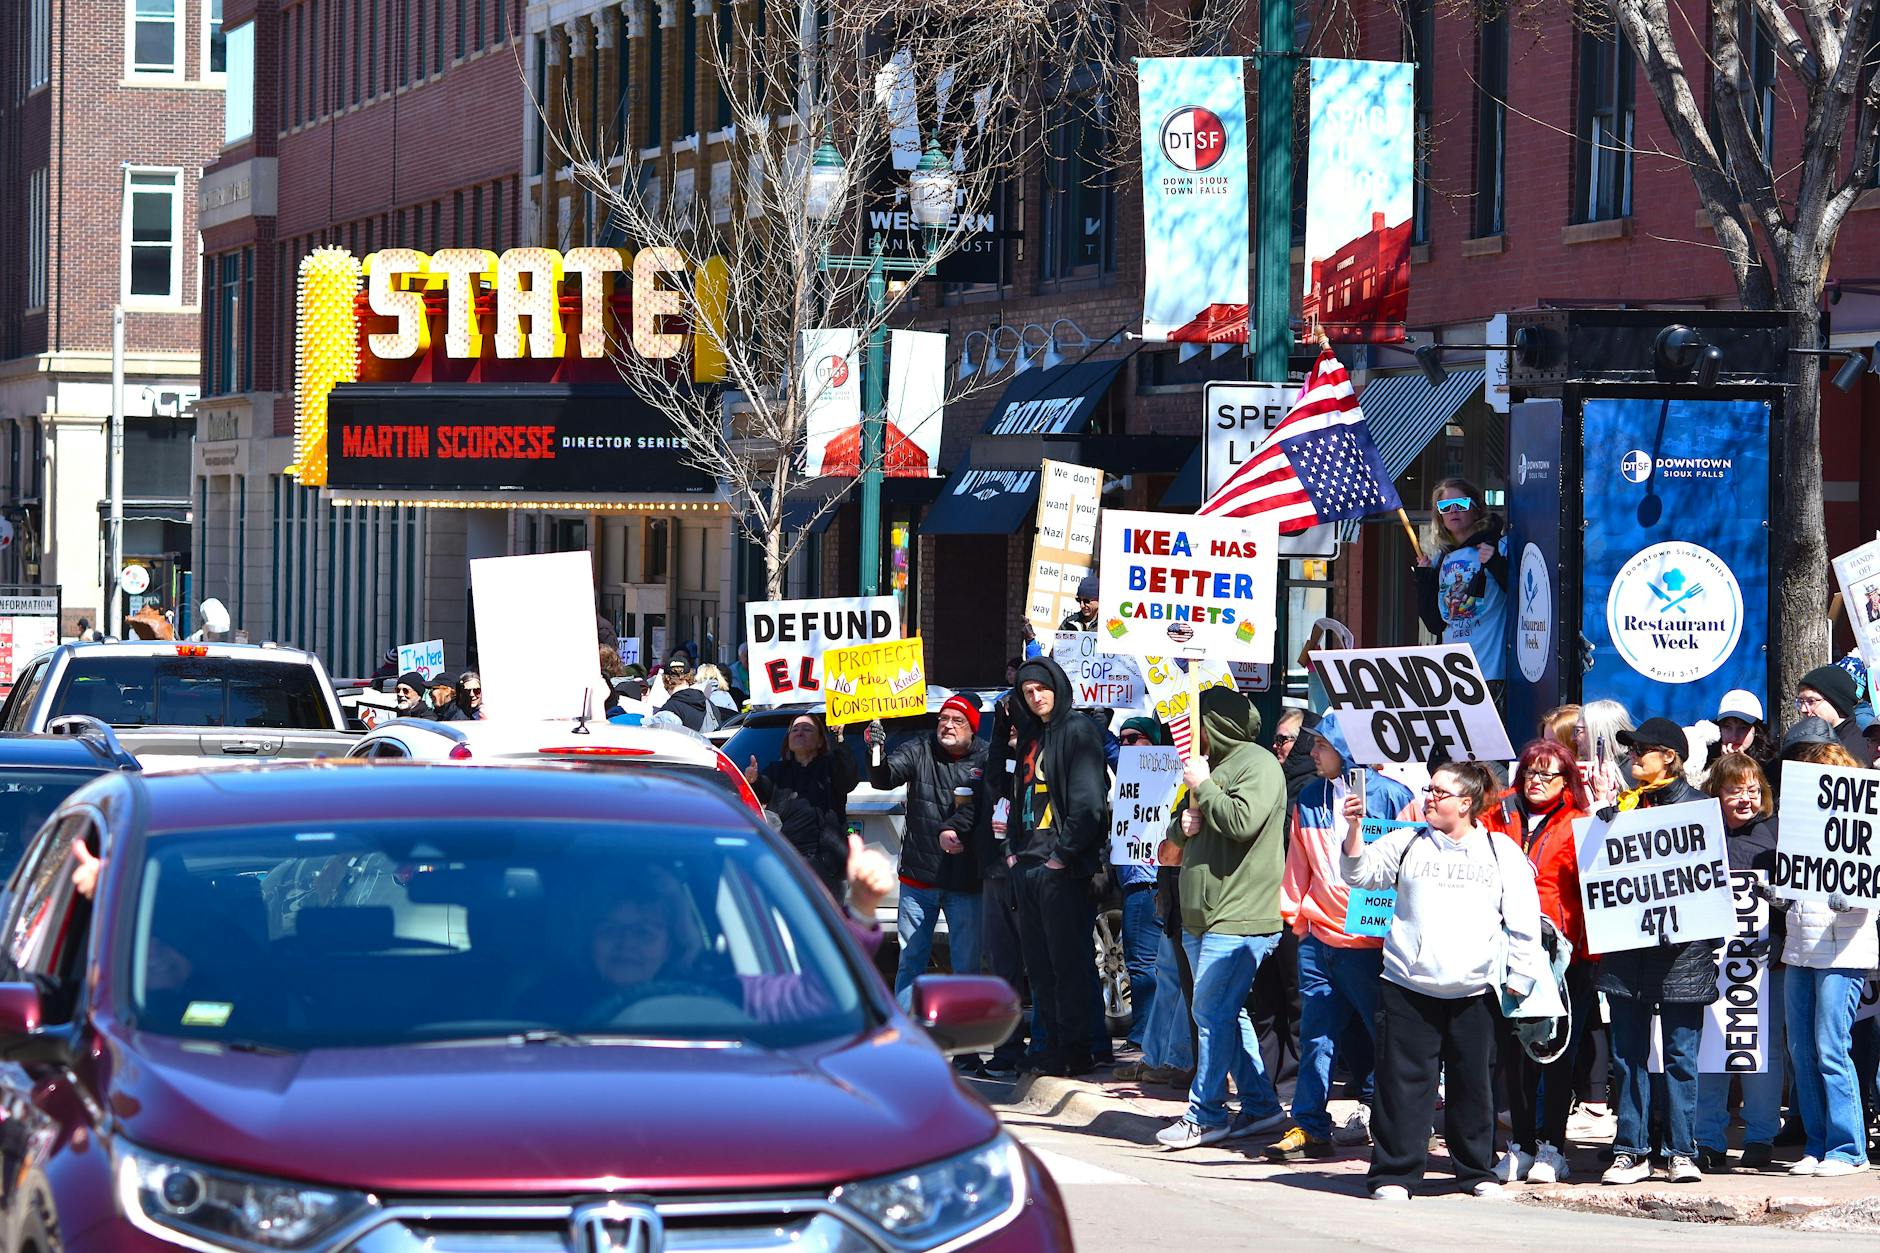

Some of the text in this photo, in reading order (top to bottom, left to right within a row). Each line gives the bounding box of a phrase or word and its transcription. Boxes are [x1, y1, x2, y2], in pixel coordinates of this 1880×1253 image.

[1169, 131, 1219, 150] DTSF
[1163, 176, 1229, 185] DOWN SIOUX
[1164, 186, 1228, 195] TOWN FALLS
[869, 210, 995, 233] WESERN
[868, 238, 916, 251] BANK
[367, 246, 686, 360] STATE
[1216, 404, 1293, 430] SPE
[342, 425, 690, 460] MARTIN SCORSESE DIRECTOR SERIES
[1623, 461, 1649, 472] DTSF
[1655, 458, 1732, 469] DOWNTOWN
[1054, 467, 1096, 486] We don't
[1663, 470, 1725, 478] SIOUX FALLS
[1045, 499, 1069, 511] want
[1043, 526, 1092, 546] Nazi cars,
[1123, 528, 1257, 559] IKEA HAS
[1625, 549, 1672, 577] Downtown
[1676, 548, 1703, 560] Sioux
[1848, 552, 1876, 569] HANDS
[1857, 564, 1873, 577] OFF
[1039, 565, 1060, 578] take
[1128, 565, 1254, 600] BETTER
[1032, 605, 1075, 618] way tri
[1119, 601, 1236, 625] CABINETS
[753, 609, 893, 643] DEFUND
[1624, 615, 1727, 632] Restaurant
[1651, 633, 1699, 650] Week
[401, 645, 443, 671] I'm here
[837, 643, 919, 673] PROTECT
[1238, 662, 1258, 673] ZONE
[858, 671, 887, 686] the
[1080, 659, 1113, 680] GOP
[1649, 666, 1676, 679] April
[1312, 652, 1486, 710] HANDS
[1079, 682, 1133, 704] WTF?!!
[831, 693, 925, 719] CONSTITUTION
[1155, 690, 1191, 718] SAV
[1370, 709, 1477, 763] OFF!
[1119, 782, 1140, 800] ARE
[1817, 773, 1880, 815] SAVE
[1133, 803, 1161, 823] SICK
[1116, 820, 1129, 837] OF
[1824, 816, 1873, 856] OUR
[1126, 841, 1152, 860] THIS
[1605, 823, 1706, 866] DEVOUR
[1412, 861, 1494, 888] LAS VEGAS
[1586, 859, 1728, 910] FECULENCE
[1364, 897, 1393, 908] MORE
[1360, 915, 1387, 927] BANK
[1640, 904, 1680, 938] 47!
